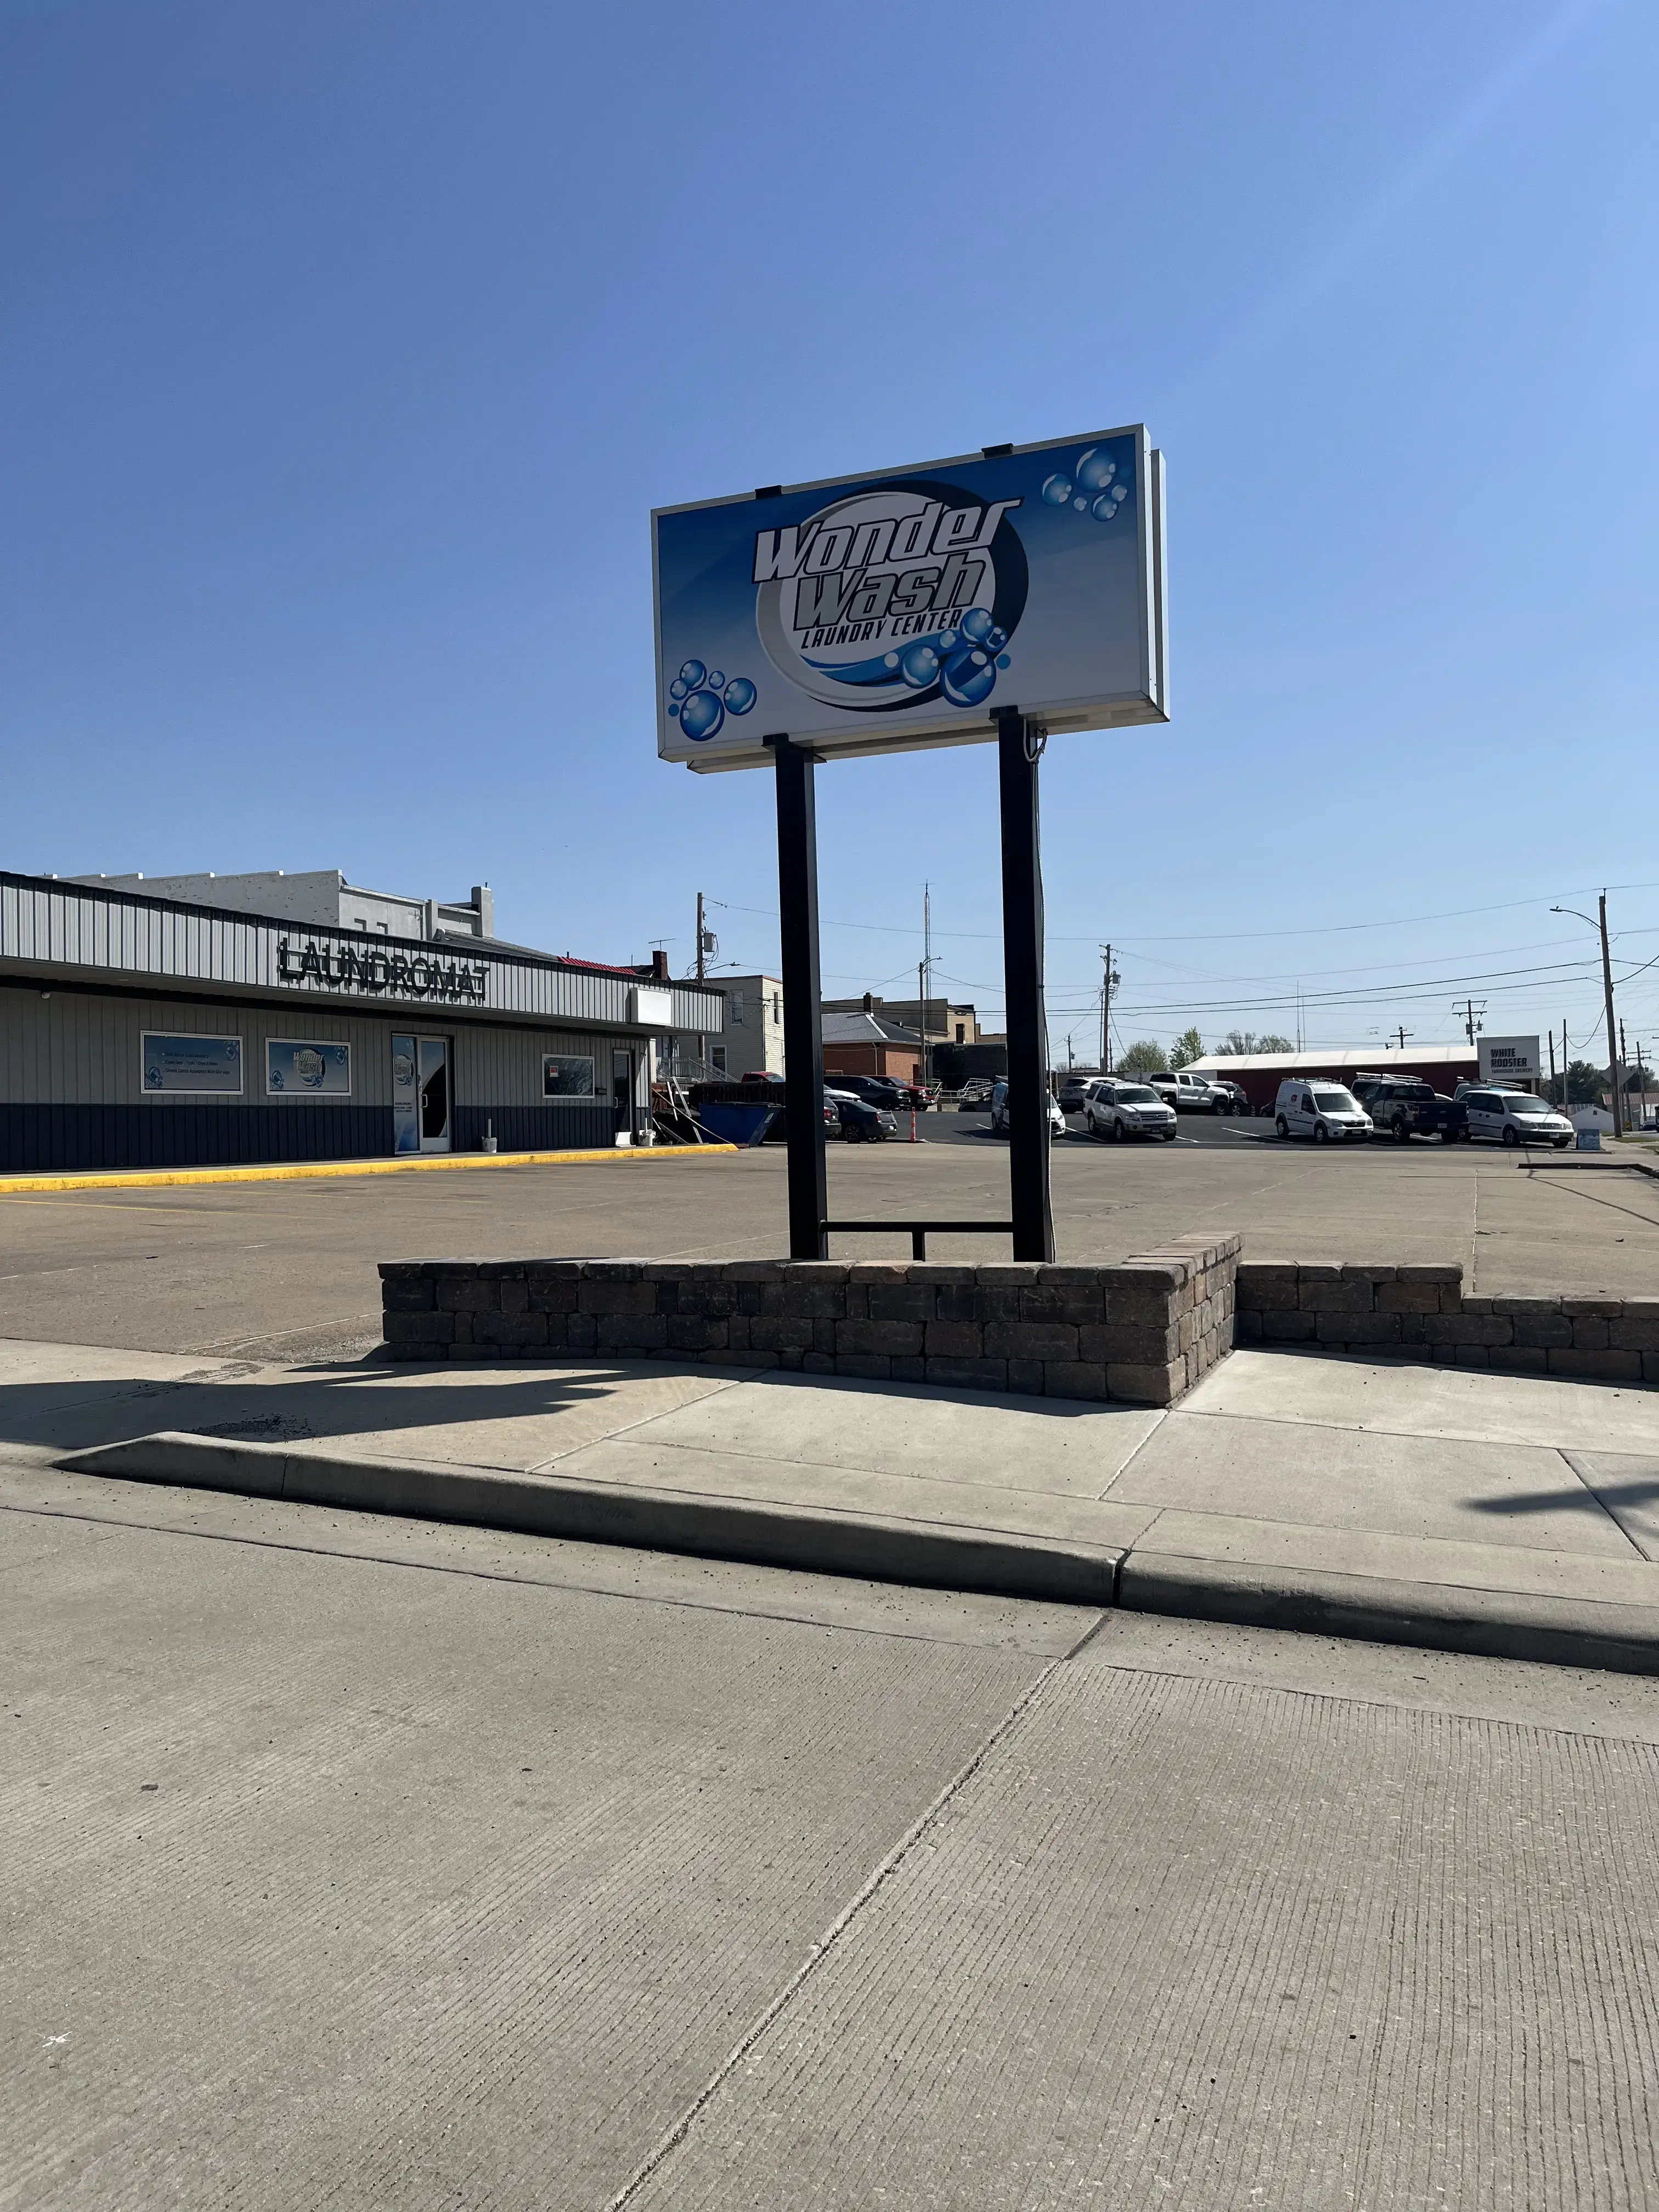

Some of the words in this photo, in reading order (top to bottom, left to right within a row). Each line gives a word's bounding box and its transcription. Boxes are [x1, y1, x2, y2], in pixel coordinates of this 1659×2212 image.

[753, 497, 1024, 583] Wonder
[793, 551, 986, 630] Wash
[801, 619, 887, 649] LAUNDRY
[890, 608, 963, 637] CENTER
[278, 937, 490, 1001] LAUNDROMAT
[293, 1052, 325, 1062] Wonder
[1490, 1048, 1516, 1058] WHITE
[1490, 1058, 1527, 1068] ROOSTER
